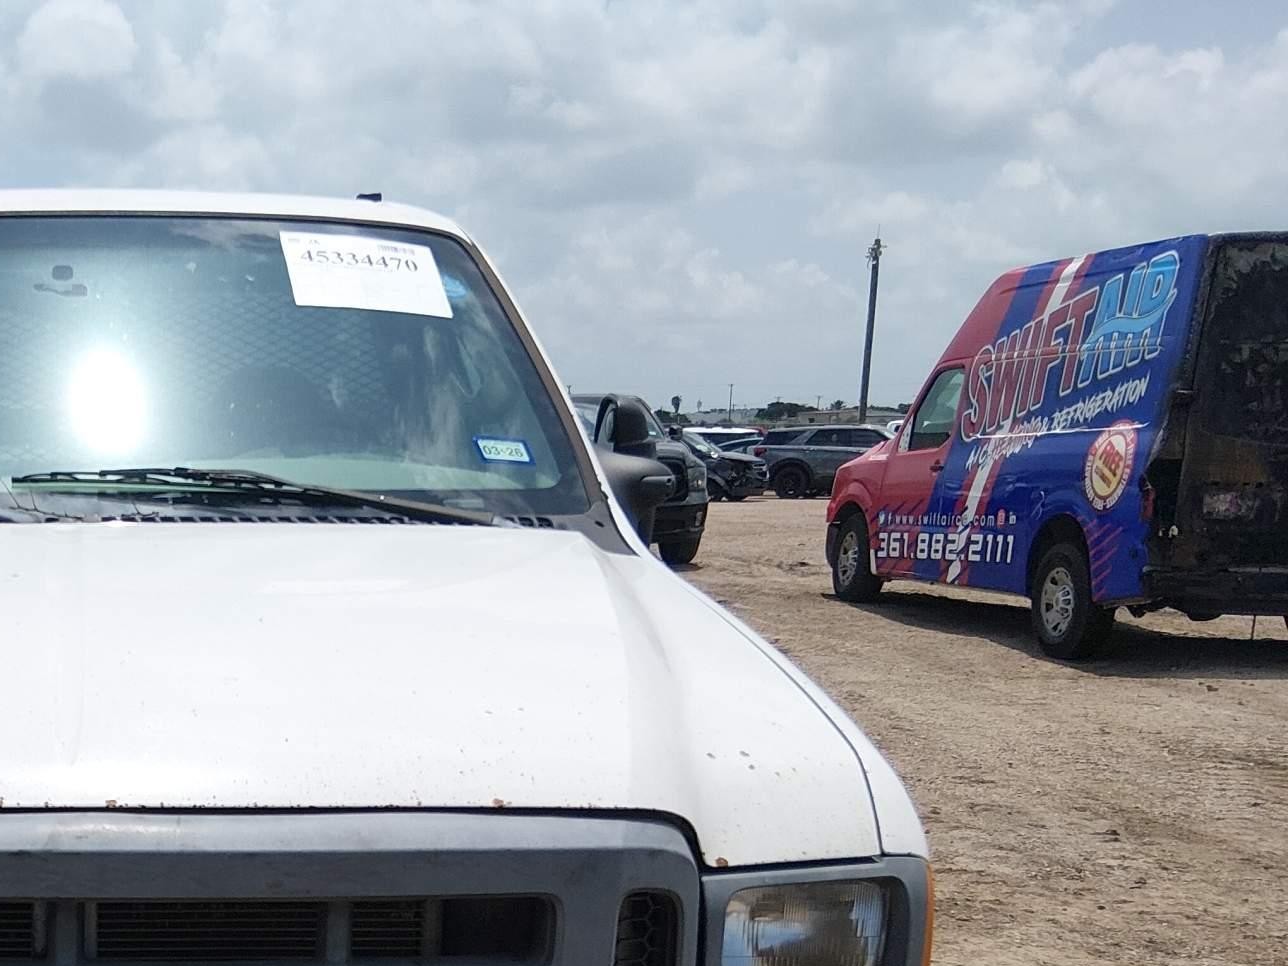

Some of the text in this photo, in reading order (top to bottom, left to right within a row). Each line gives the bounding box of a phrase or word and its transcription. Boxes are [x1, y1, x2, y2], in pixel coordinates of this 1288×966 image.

[300, 249, 419, 273] 45334470
[1050, 372, 1150, 429] REFRIGERATION
[877, 532, 1014, 564] 361.882.2111
